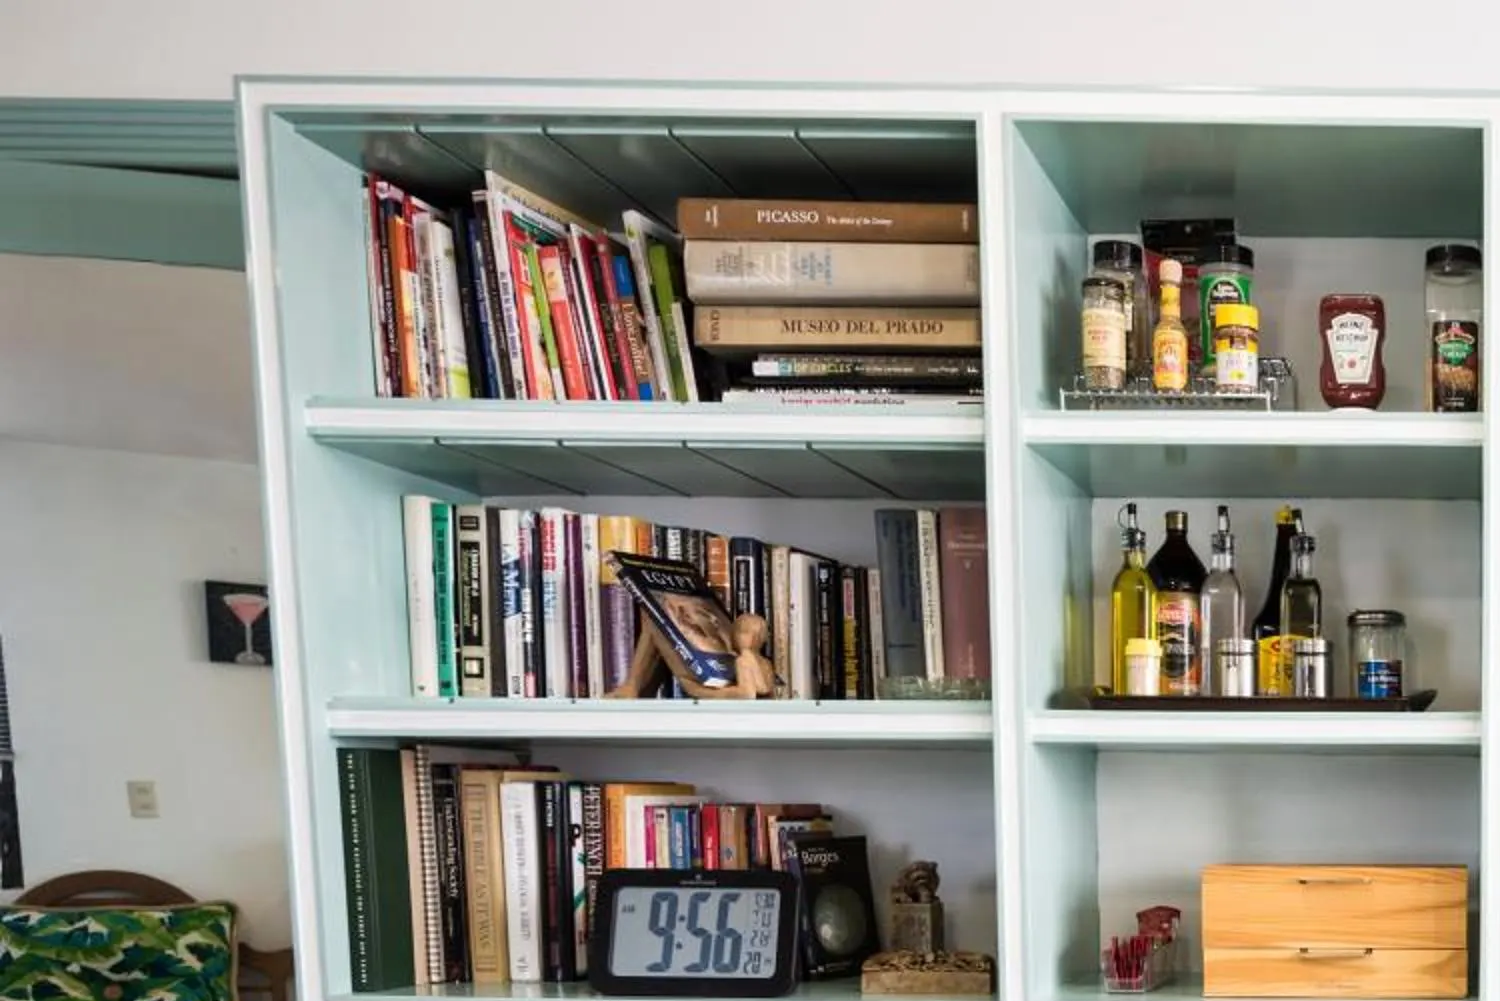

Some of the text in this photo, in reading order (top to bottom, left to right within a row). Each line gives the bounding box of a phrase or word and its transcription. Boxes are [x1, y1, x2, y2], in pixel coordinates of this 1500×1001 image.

[757, 209, 820, 225] PICASSO
[780, 318, 944, 335] MUSEO DEL PRADO
[628, 334, 649, 377] coffee!
[641, 569, 697, 590] EGYPT
[470, 807, 485, 836] THE
[583, 785, 604, 876] PETER LYNCH
[443, 797, 460, 898] Understanding Society
[801, 849, 839, 867] Borges
[645, 891, 743, 974] 9:56
